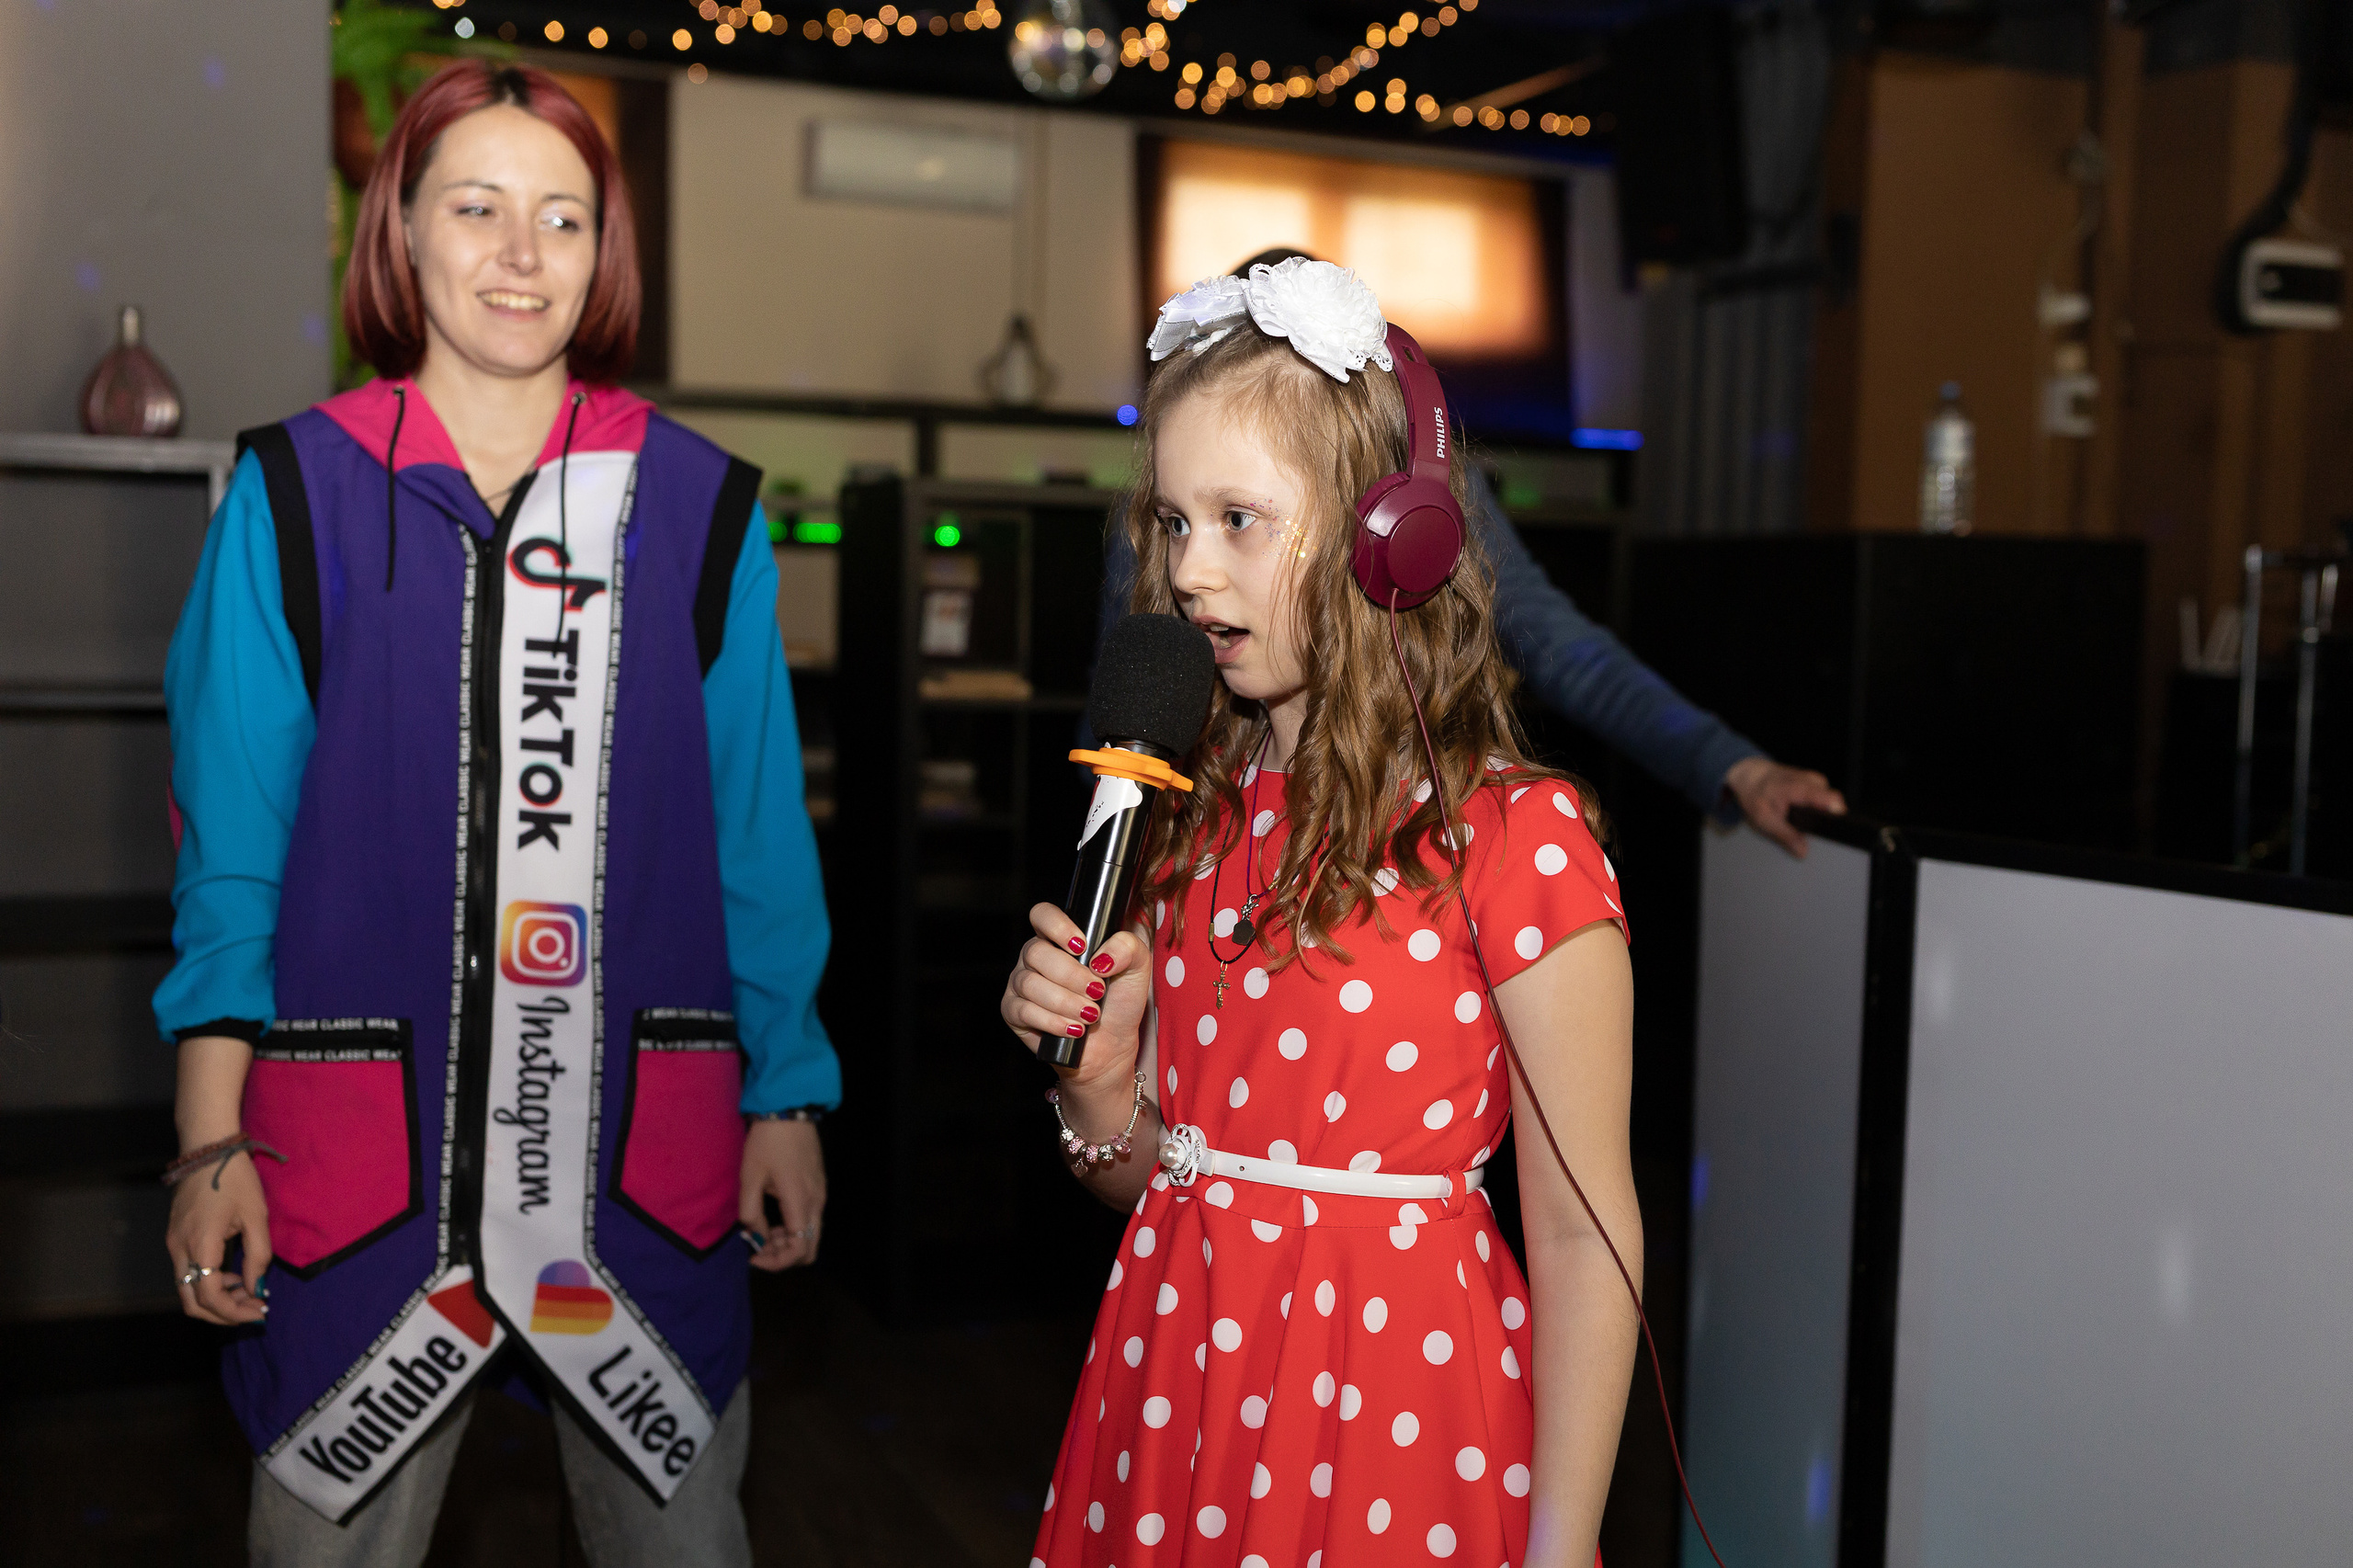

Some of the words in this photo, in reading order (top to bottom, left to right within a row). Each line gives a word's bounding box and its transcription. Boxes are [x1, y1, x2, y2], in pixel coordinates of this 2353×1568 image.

[1436, 407, 1444, 459] PHILIPS
[517, 629, 579, 851] TikTok
[320, 1017, 364, 1030] CLASSIC
[324, 1048, 370, 1062] CLASSIC
[494, 996, 570, 1215] Instagram
[299, 1335, 468, 1484] YouTube
[587, 1346, 696, 1477] Likee
